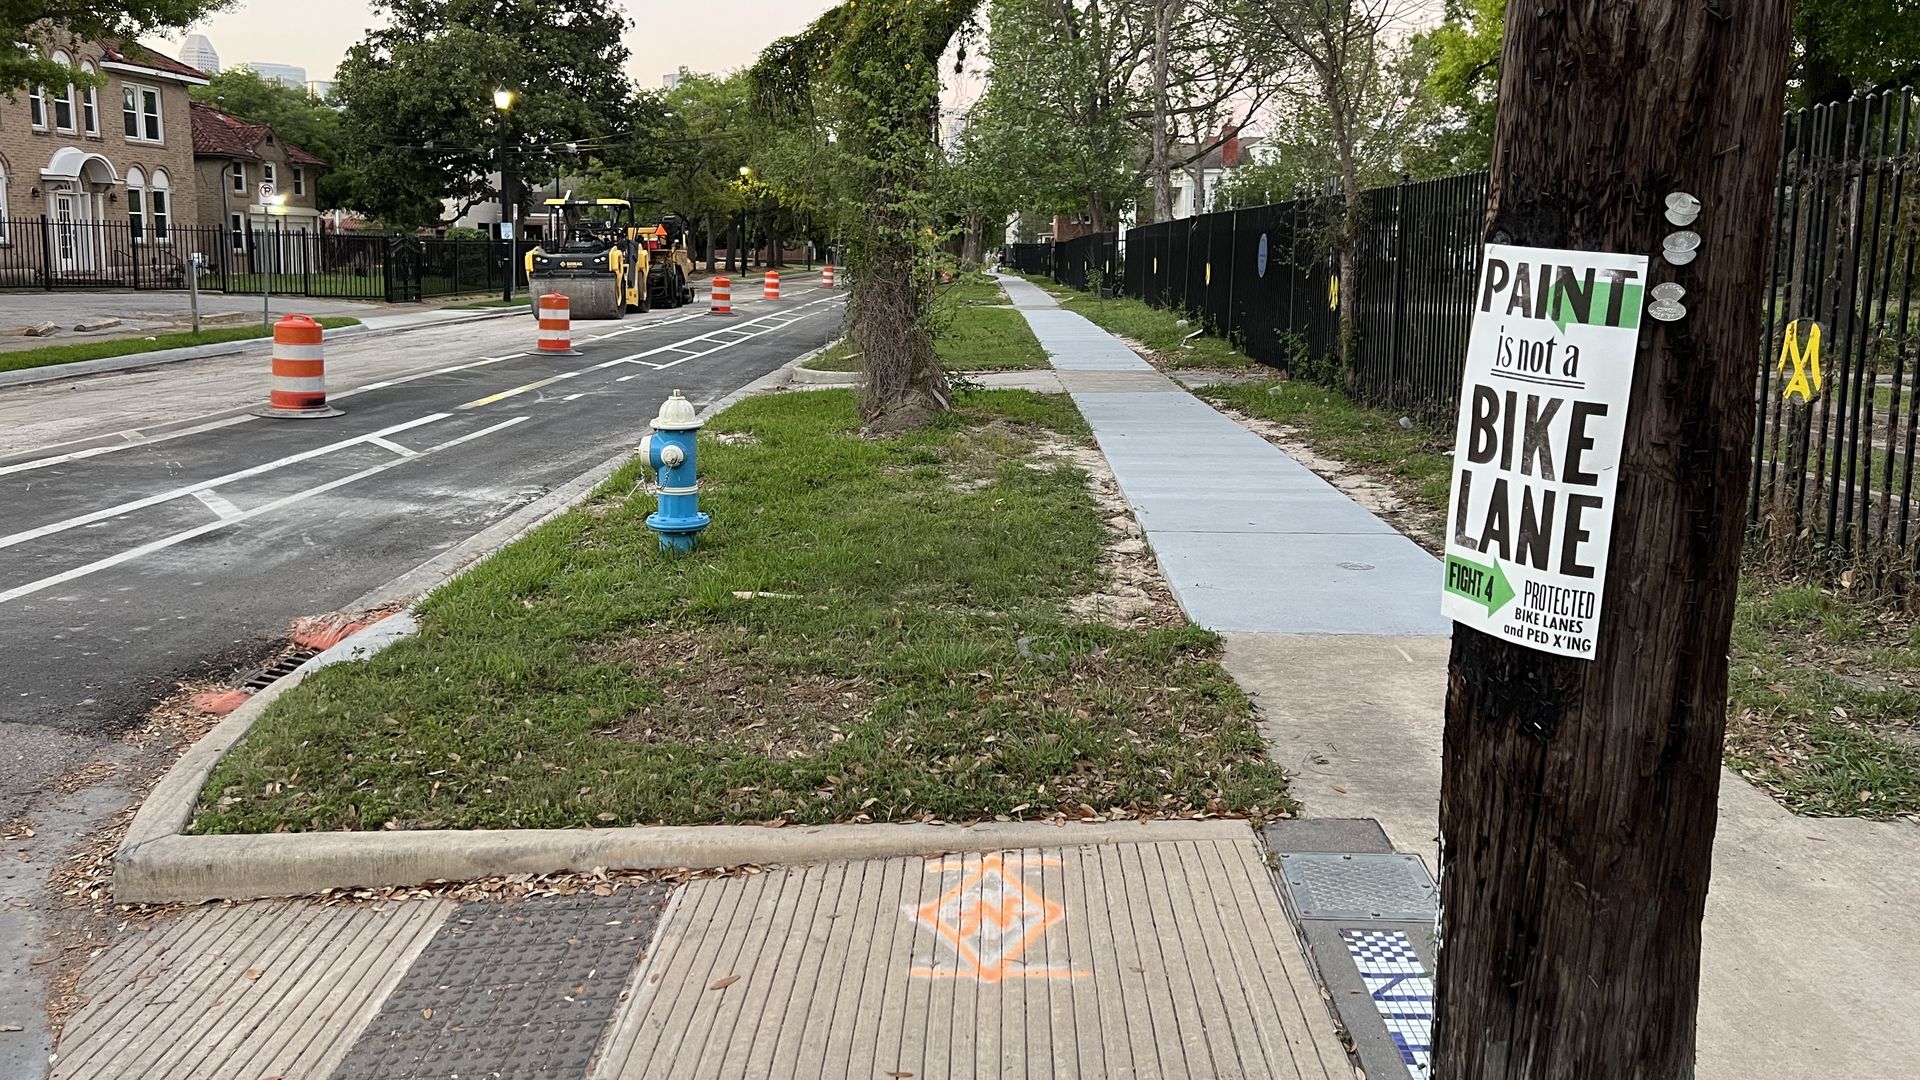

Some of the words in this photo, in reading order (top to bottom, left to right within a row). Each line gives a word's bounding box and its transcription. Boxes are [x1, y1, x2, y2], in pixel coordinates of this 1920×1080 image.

[1481, 259, 1638, 326] PAINT
[1496, 326, 1513, 368] is
[1517, 335, 1557, 376] not
[1562, 345, 1579, 378] a
[1467, 384, 1608, 486] BIKE
[1454, 470, 1603, 579] LANE
[1449, 562, 1484, 598] FIGHT
[1484, 575, 1494, 602] 4
[1524, 580, 1594, 619] PROTECTED
[1504, 623, 1523, 639] and
[1527, 627, 1549, 644] PED
[1553, 634, 1592, 651] X'ING
[1515, 607, 1539, 625] BIKE
[1543, 613, 1583, 633] LANES
